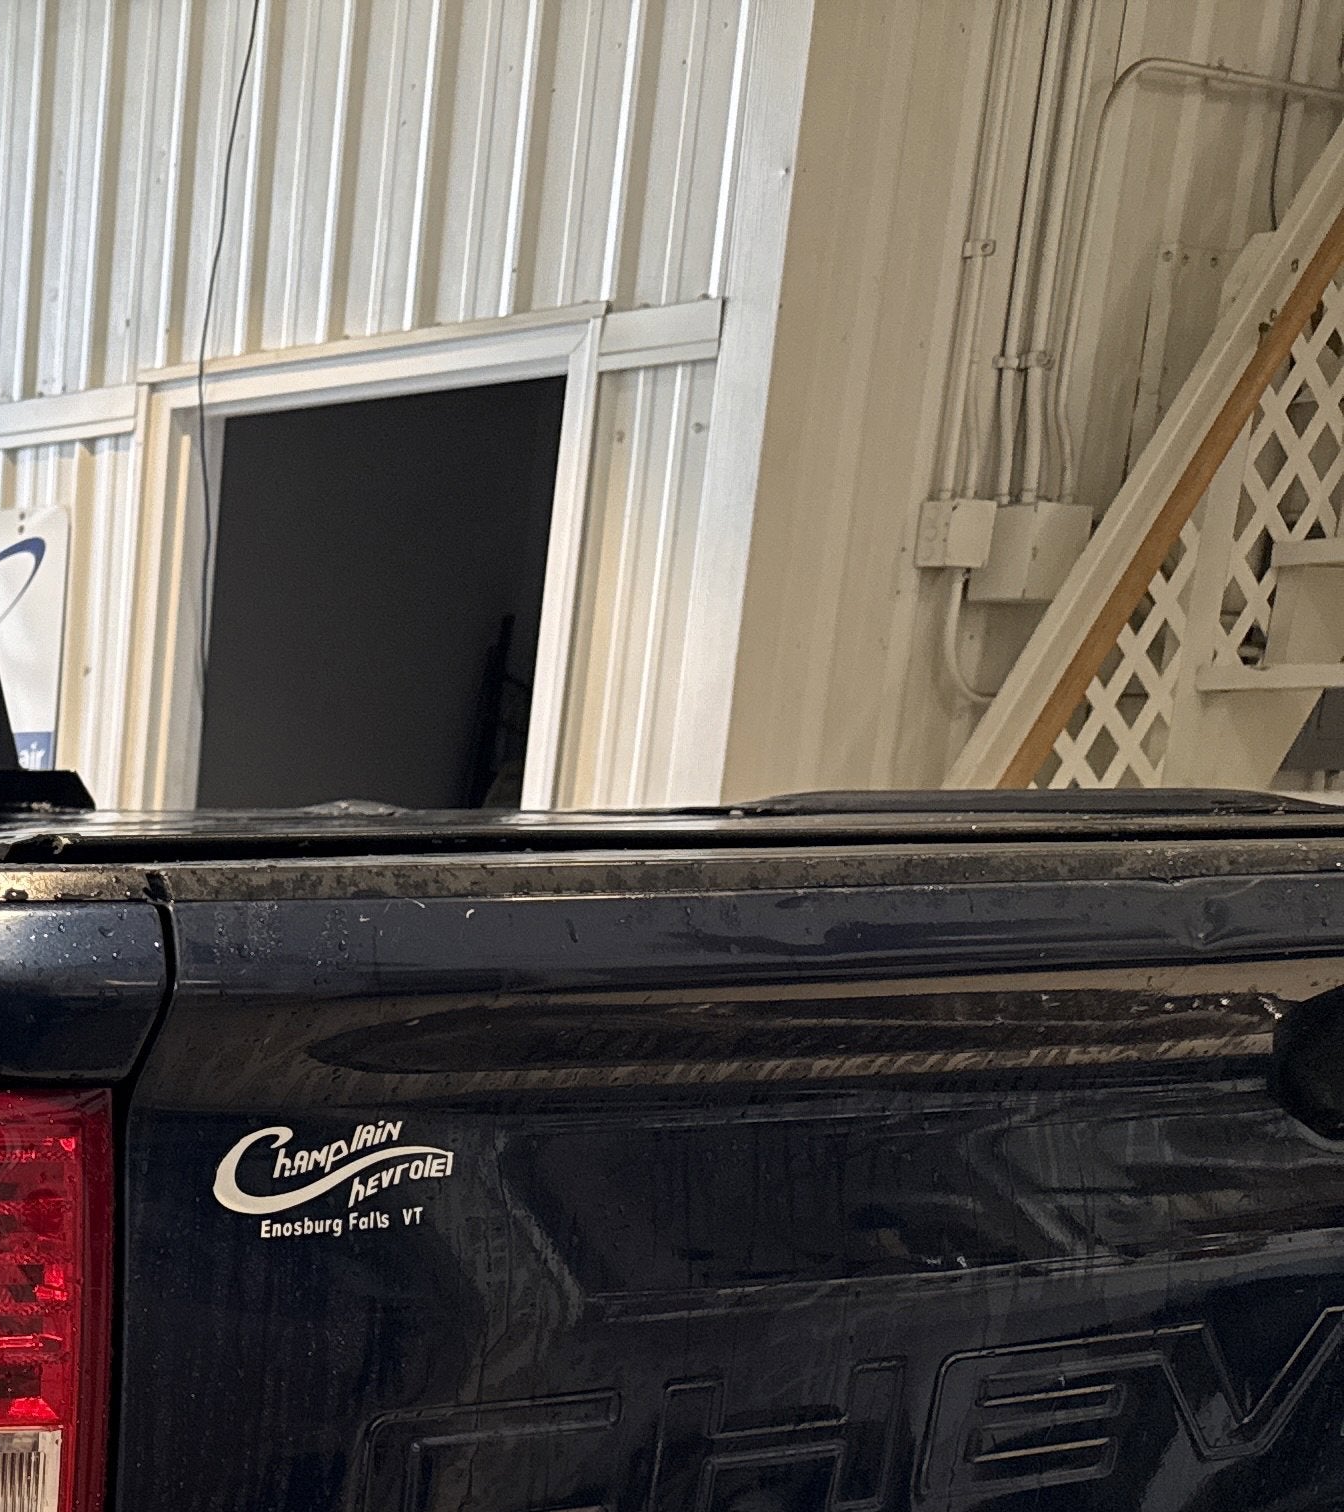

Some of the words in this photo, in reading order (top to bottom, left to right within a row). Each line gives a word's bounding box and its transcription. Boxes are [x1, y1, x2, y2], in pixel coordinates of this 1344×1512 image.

[260, 1216, 343, 1239] Enosburg
[349, 1211, 390, 1231] Falls
[402, 1207, 424, 1226] VT
